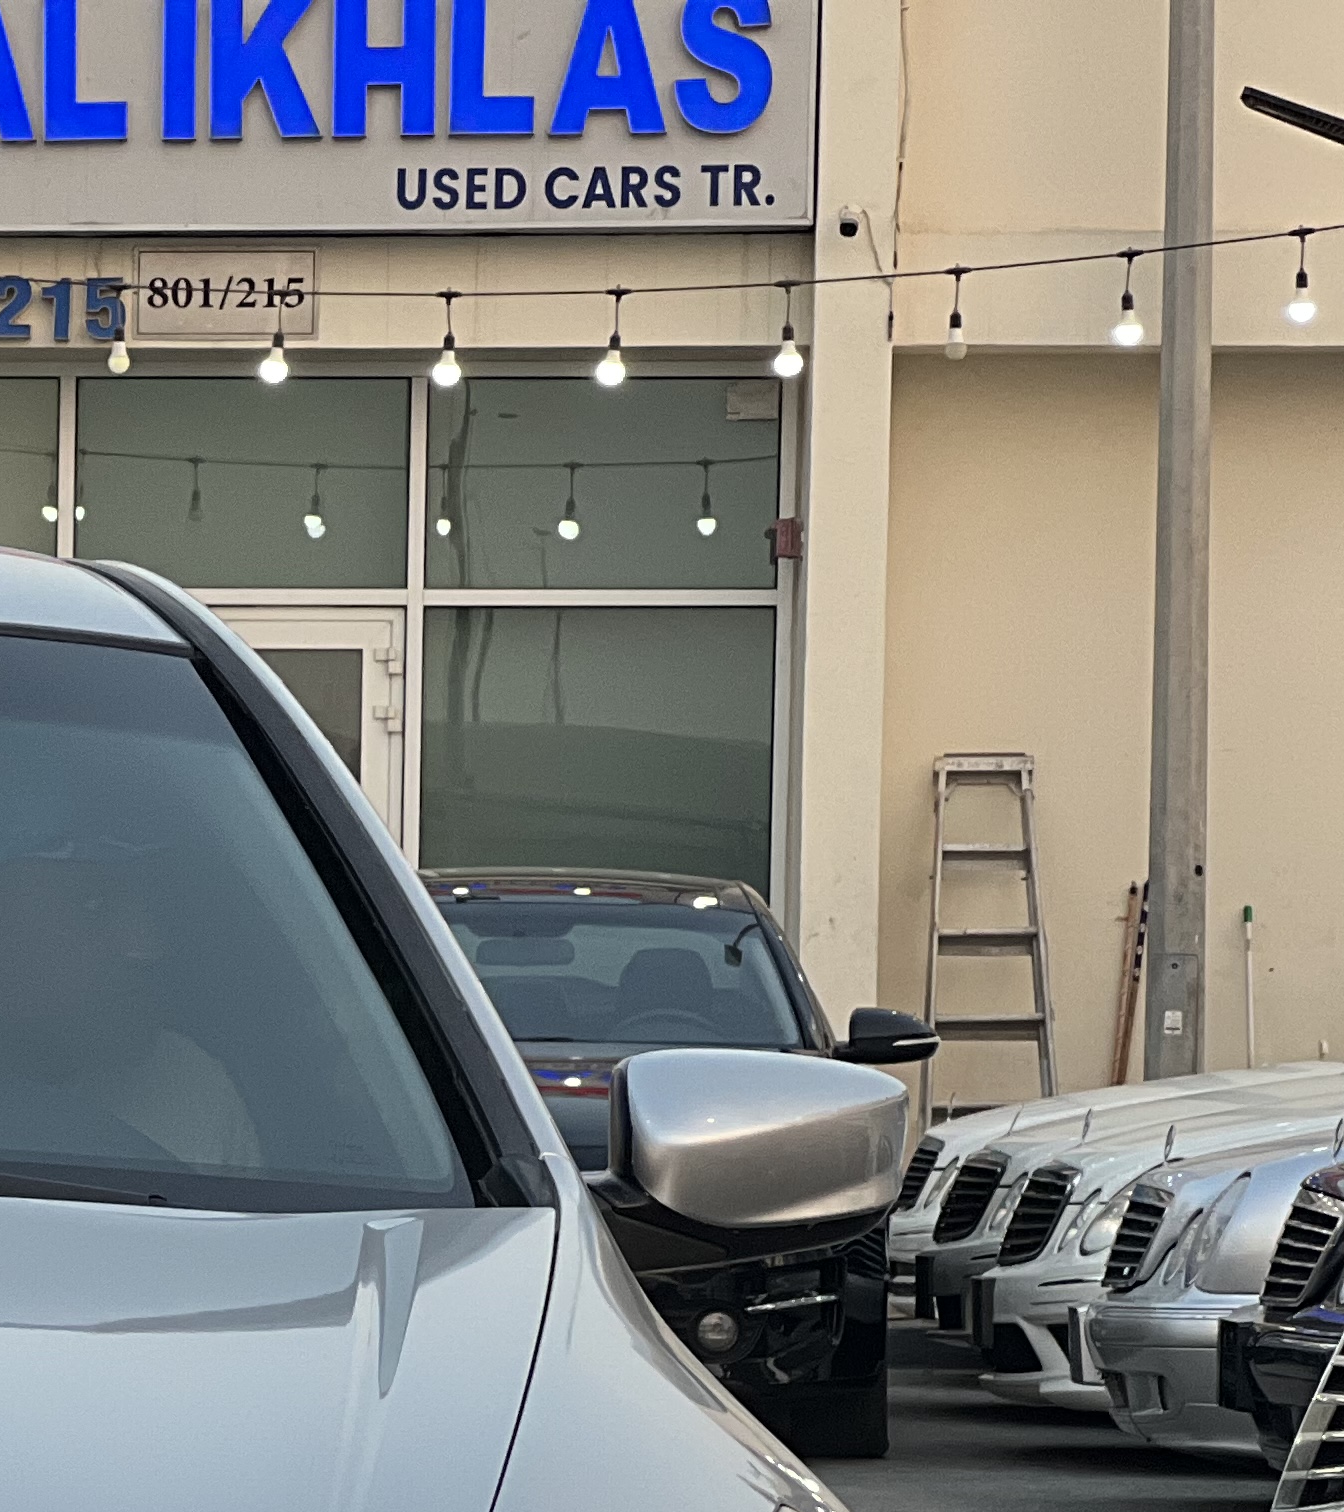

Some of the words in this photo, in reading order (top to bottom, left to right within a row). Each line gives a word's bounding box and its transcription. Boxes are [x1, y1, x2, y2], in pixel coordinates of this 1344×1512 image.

[161, 0, 775, 142] IKHLAS
[395, 166, 527, 211] USED
[543, 164, 682, 210] CARS
[699, 162, 776, 209] TR.
[146, 275, 305, 310] 801/215
